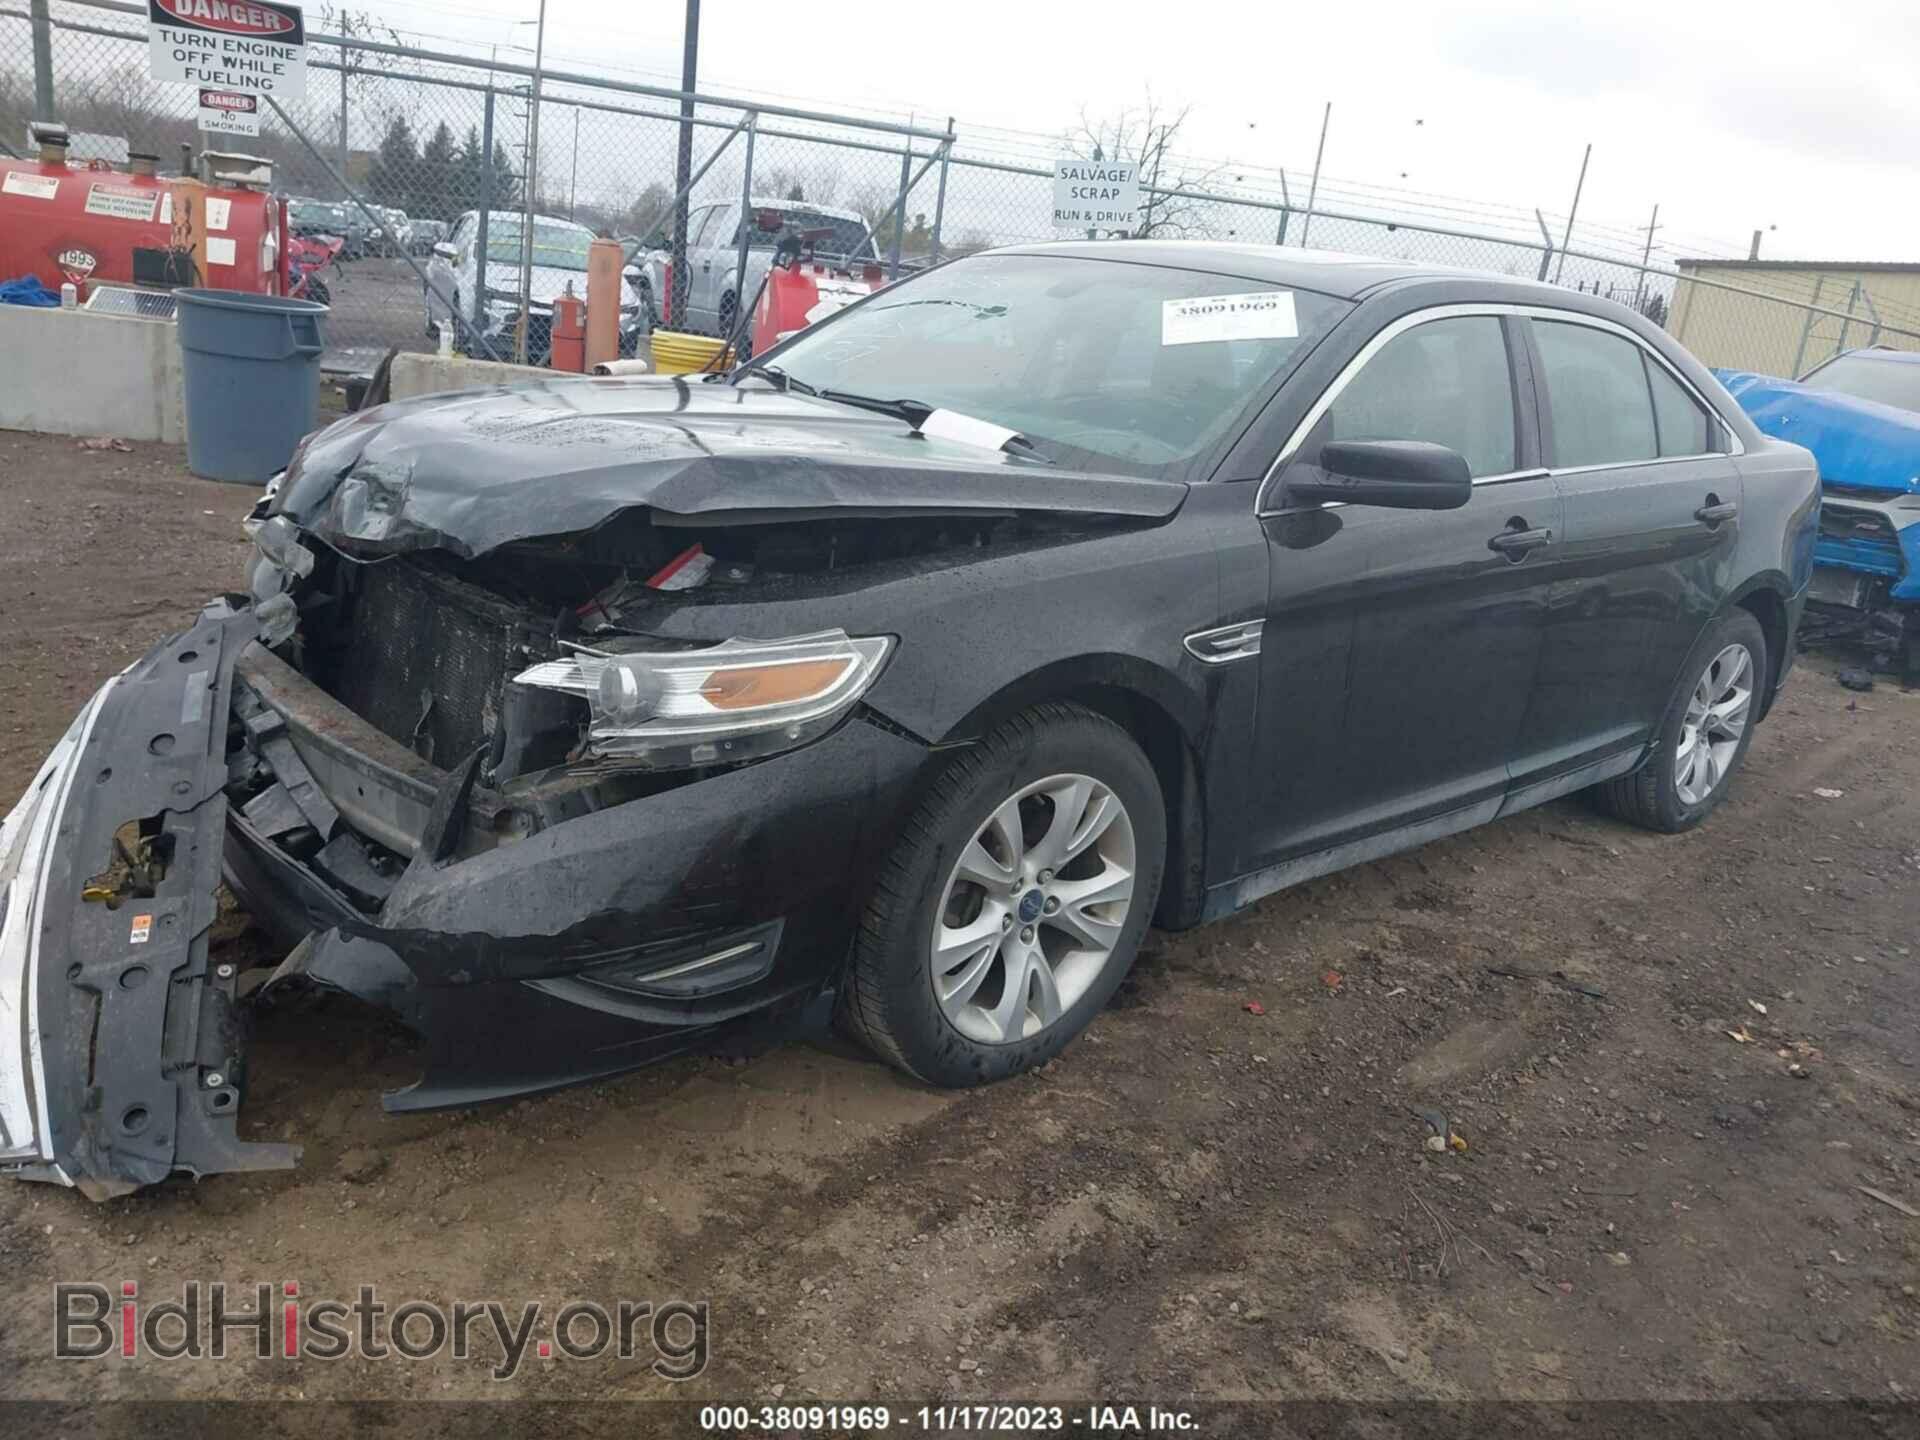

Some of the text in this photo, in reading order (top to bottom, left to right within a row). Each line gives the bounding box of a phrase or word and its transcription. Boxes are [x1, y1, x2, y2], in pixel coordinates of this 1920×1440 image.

[175, 0, 281, 29] DANGER
[159, 29, 297, 61] TURN ENGINE
[173, 49, 285, 76] OFF WHILE
[185, 67, 274, 90] FUELING
[208, 94, 249, 108] DANGER
[221, 113, 236, 121] NO
[204, 120, 254, 133] SMOKING
[1061, 167, 1133, 182] SALVAGE/
[1071, 186, 1120, 200] SCRAP
[1055, 209, 1134, 222] RUN & DRIVE
